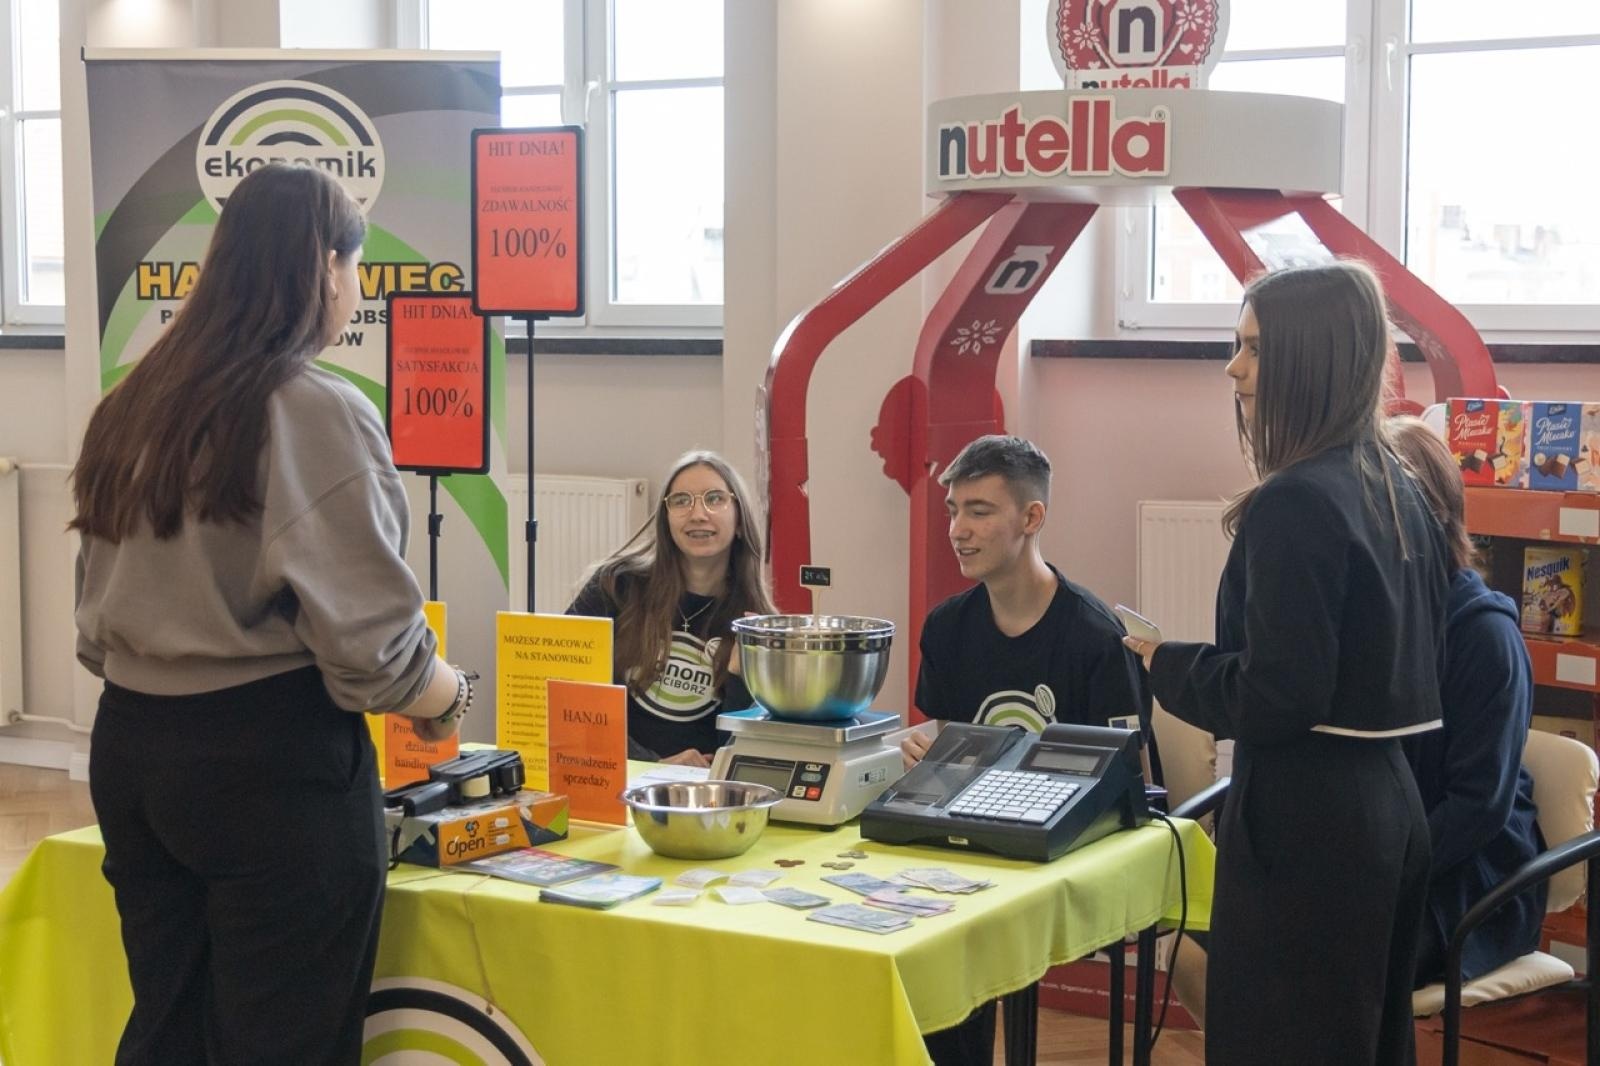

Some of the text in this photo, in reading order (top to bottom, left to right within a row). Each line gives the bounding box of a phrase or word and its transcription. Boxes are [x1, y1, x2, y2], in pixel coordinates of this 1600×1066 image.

[488, 140, 565, 157] HIT DNIA!
[204, 150, 376, 178] ekomik
[490, 227, 567, 258] 100%
[403, 304, 427, 319] HIT
[397, 360, 479, 373] SATYSFAKCJA
[404, 387, 473, 418] 100%
[1526, 556, 1570, 581] Nesquik
[542, 638, 597, 650] PRACOWAĆ
[514, 650, 593, 665] NA STANOWISKU
[556, 752, 618, 770] Prowadzenie
[563, 773, 611, 790] sprzedaży
[446, 835, 485, 858] Open
